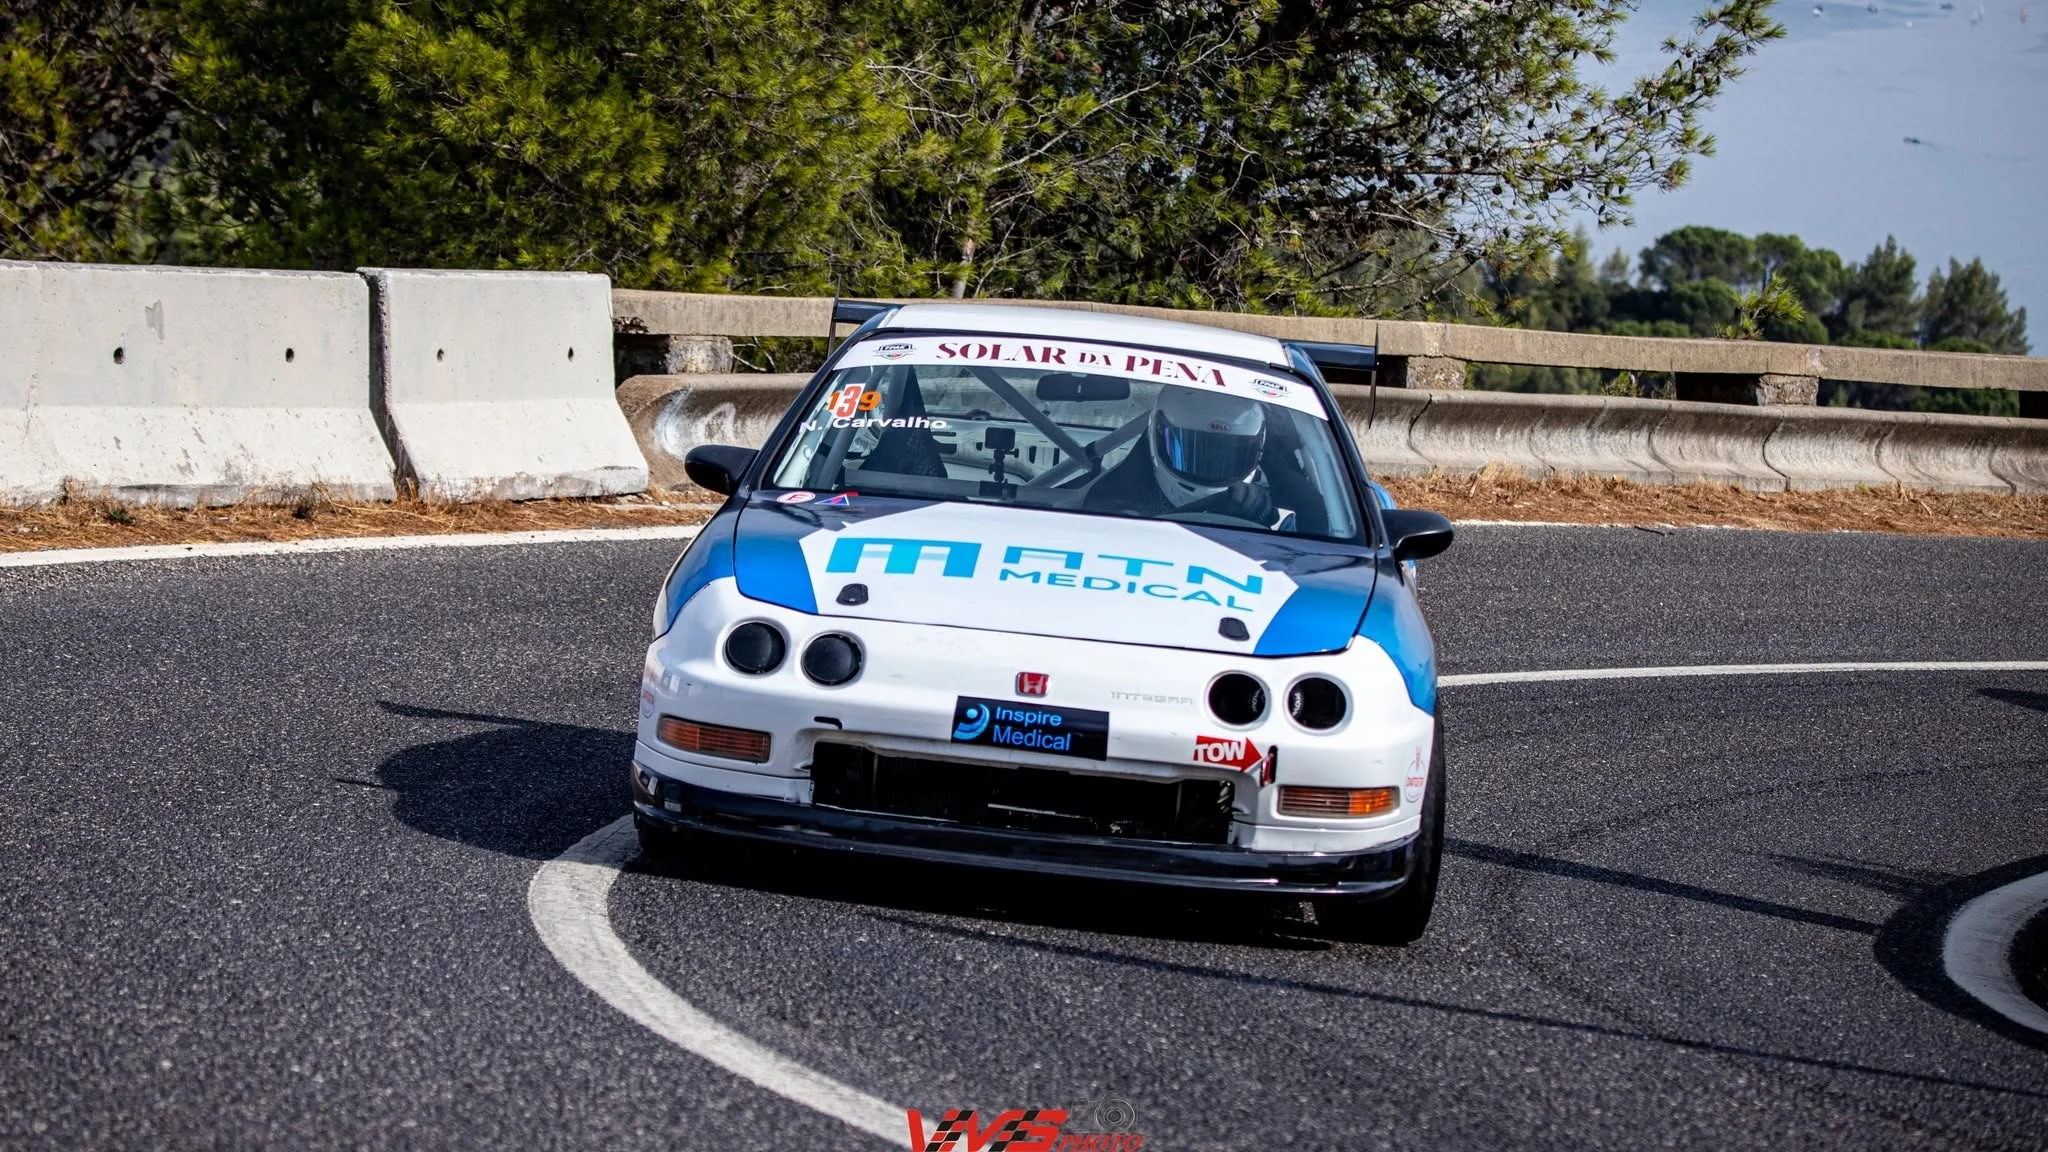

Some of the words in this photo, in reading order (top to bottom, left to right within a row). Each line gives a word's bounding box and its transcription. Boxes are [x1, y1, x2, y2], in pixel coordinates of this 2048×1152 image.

[936, 342, 1067, 365] SOLAR
[1078, 351, 1111, 368] DA
[1124, 355, 1226, 386] PENA
[828, 385, 881, 417] 139
[799, 422, 823, 433] N.
[832, 416, 948, 429] Carvalho
[999, 568, 1253, 612] MEDICAL
[995, 706, 1062, 727] Inspire
[993, 724, 1071, 751] Medical
[1194, 741, 1247, 763] TOW
